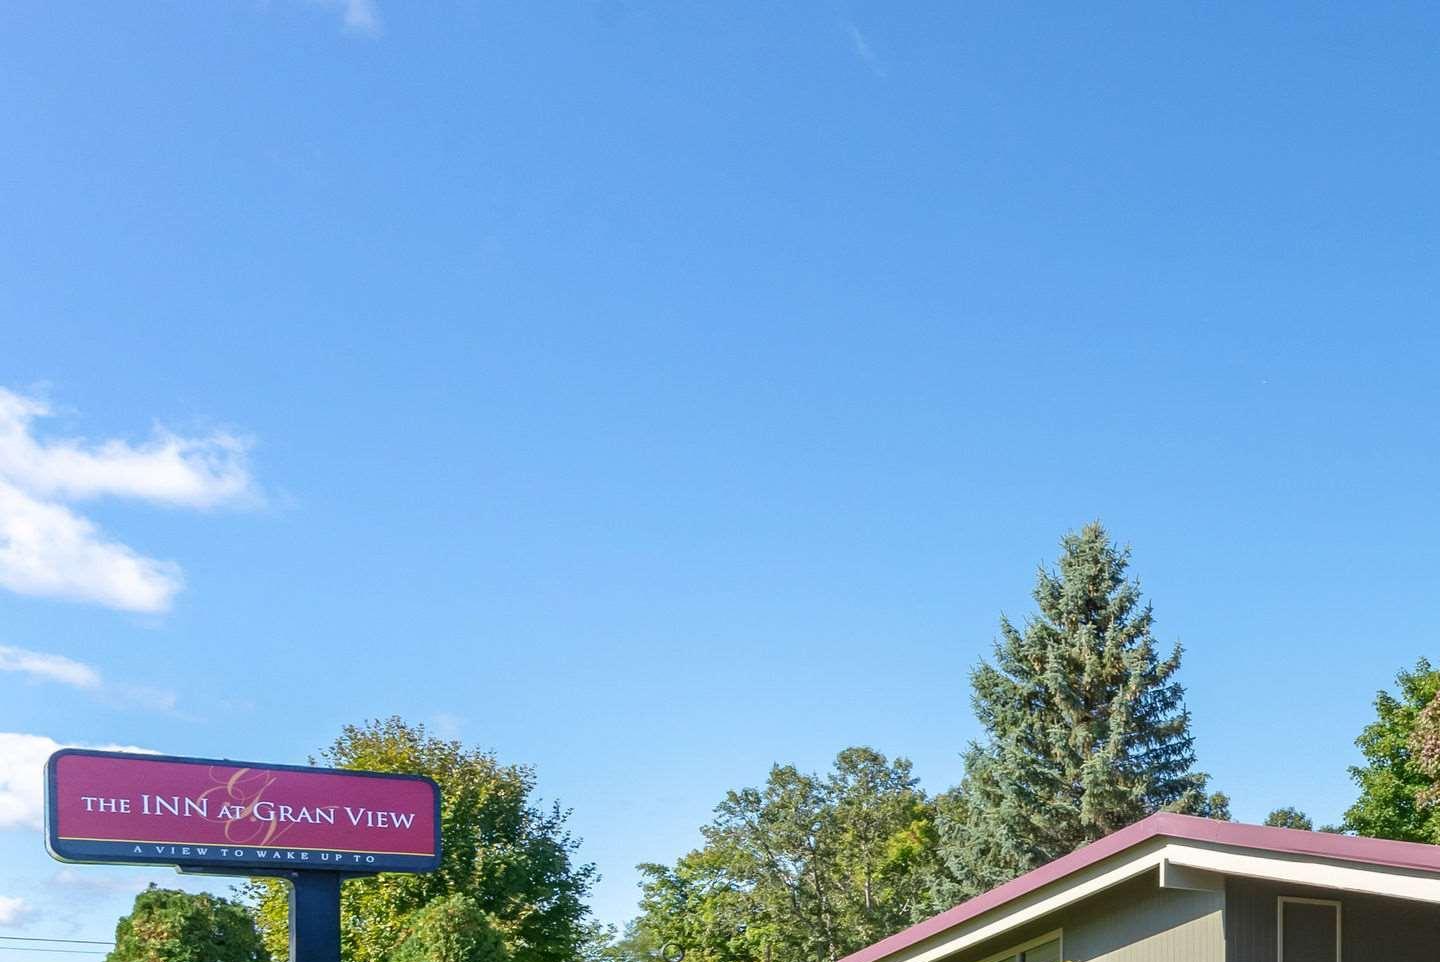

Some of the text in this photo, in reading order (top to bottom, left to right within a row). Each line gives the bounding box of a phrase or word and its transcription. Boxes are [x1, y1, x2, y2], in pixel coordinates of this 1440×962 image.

[81, 794, 416, 829] THE INN AT GRAN VIEW
[133, 846, 376, 863] A VIEW TO WAKE UP TO
